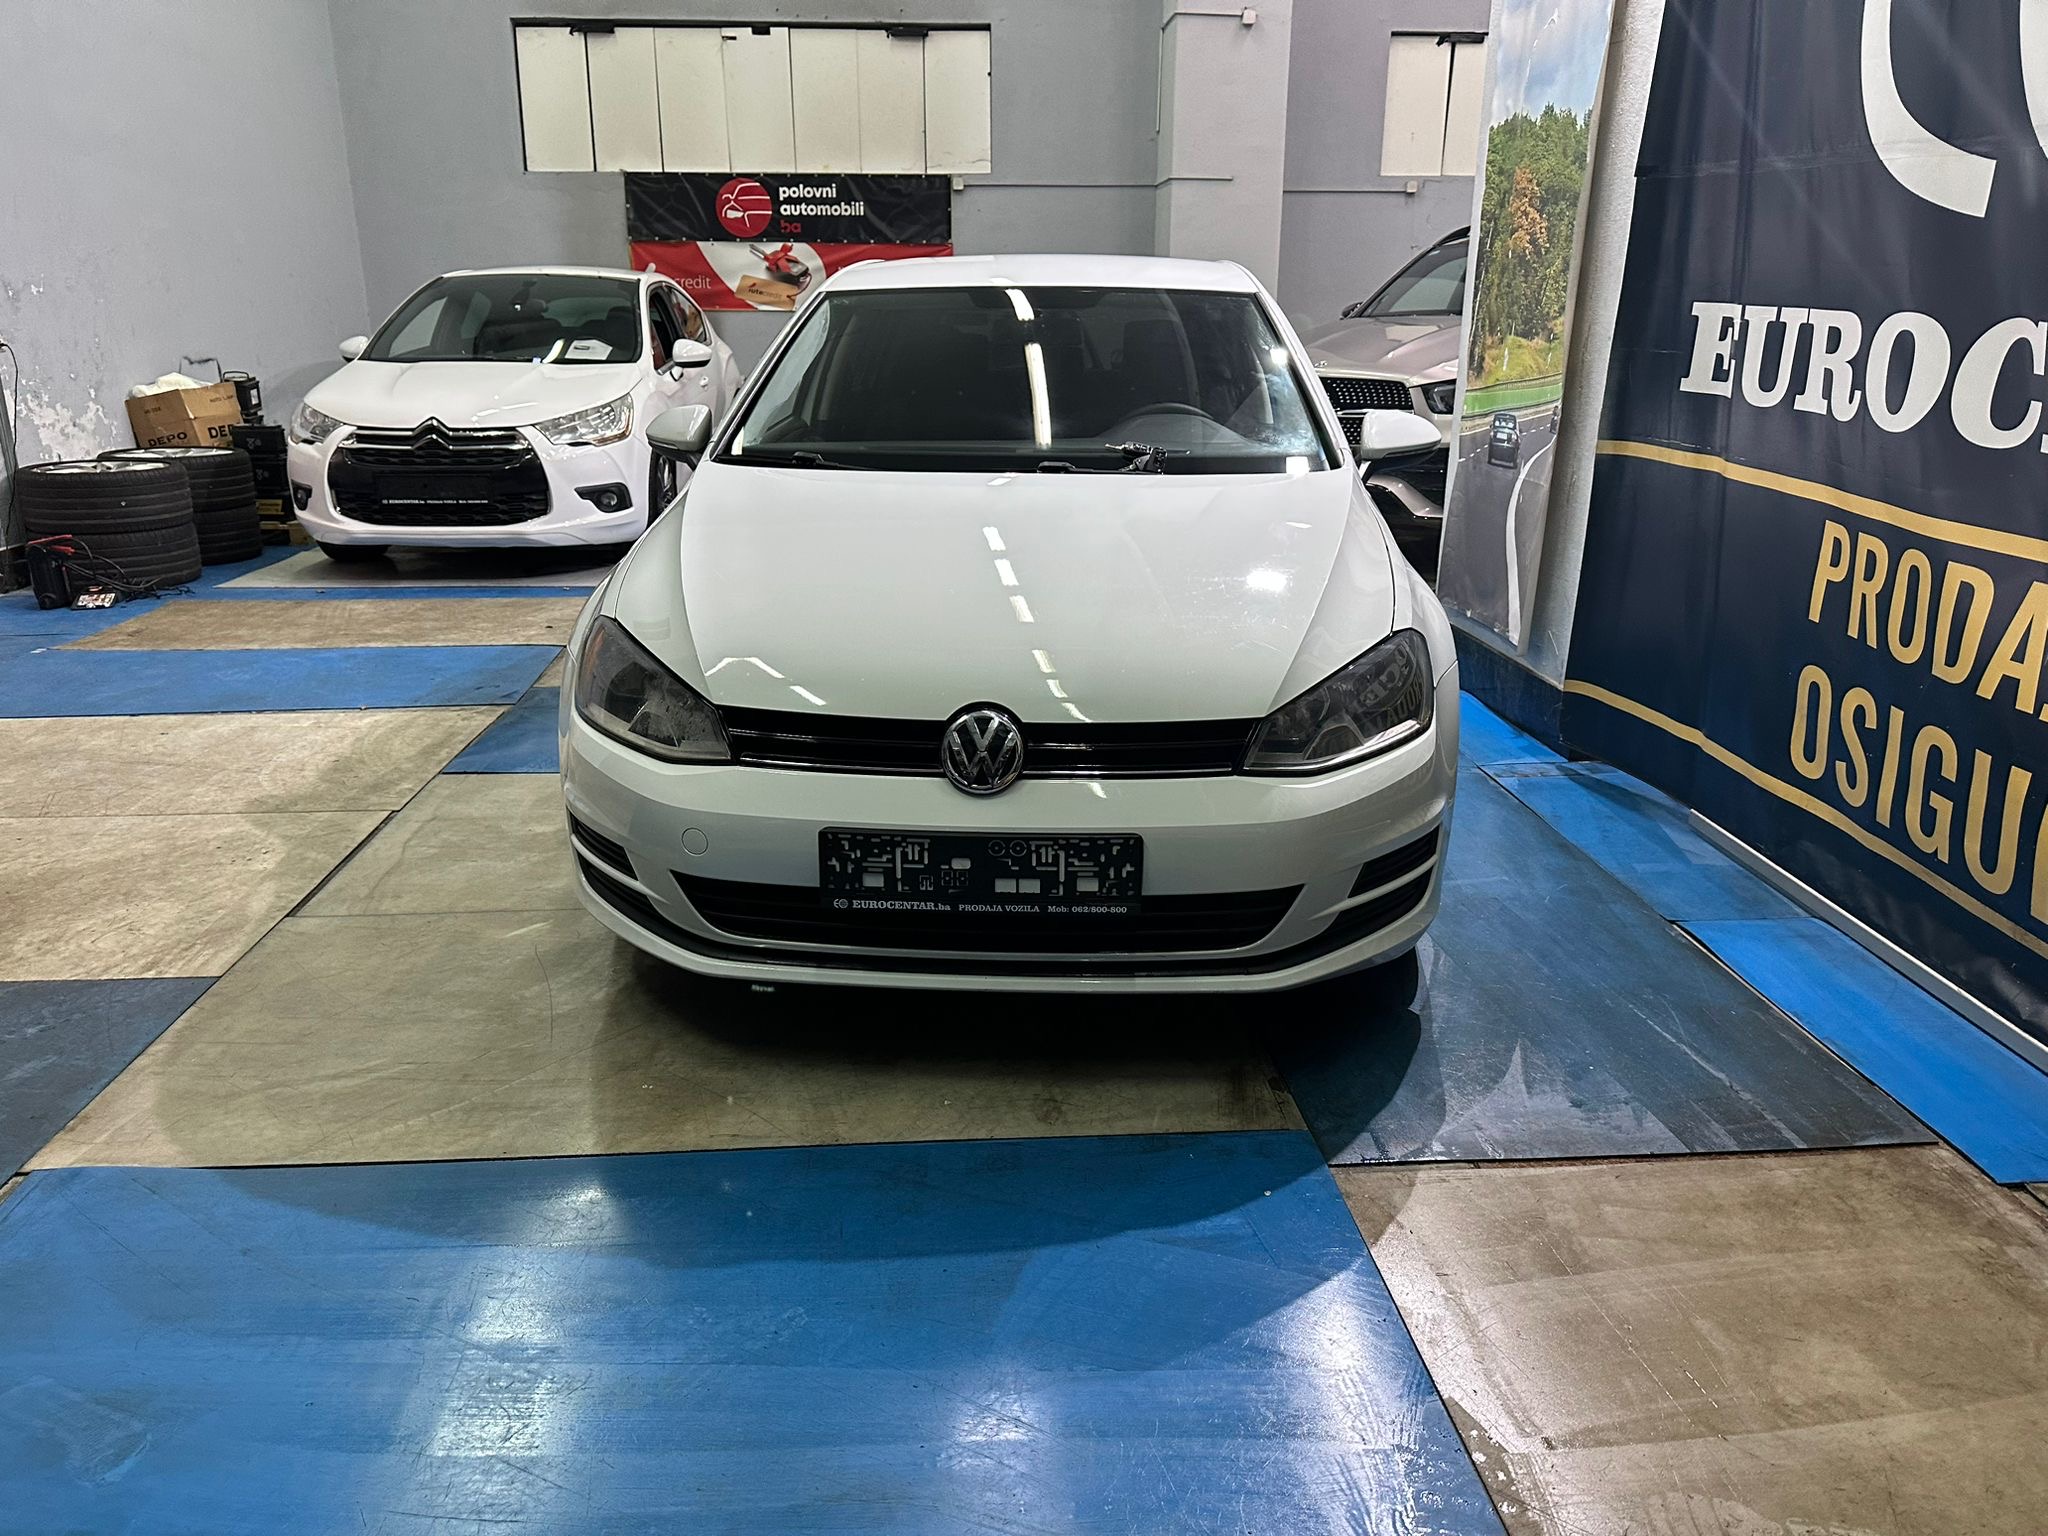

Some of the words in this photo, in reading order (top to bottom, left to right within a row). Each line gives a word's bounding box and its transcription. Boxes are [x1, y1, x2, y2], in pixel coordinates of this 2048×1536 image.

[779, 183, 837, 201] polovni
[780, 201, 865, 216] automobili
[780, 219, 802, 233] ba
[1679, 301, 2048, 455] EUROC
[147, 431, 188, 448] DEPO
[1808, 519, 2048, 723] PRODA
[852, 899, 951, 911] EUROCENTAR.ba
[958, 903, 1003, 912] PRODAJA
[1005, 904, 1040, 912] VOZILA
[1047, 905, 1070, 913] Mob:
[1072, 906, 1127, 914] 062/800-800
